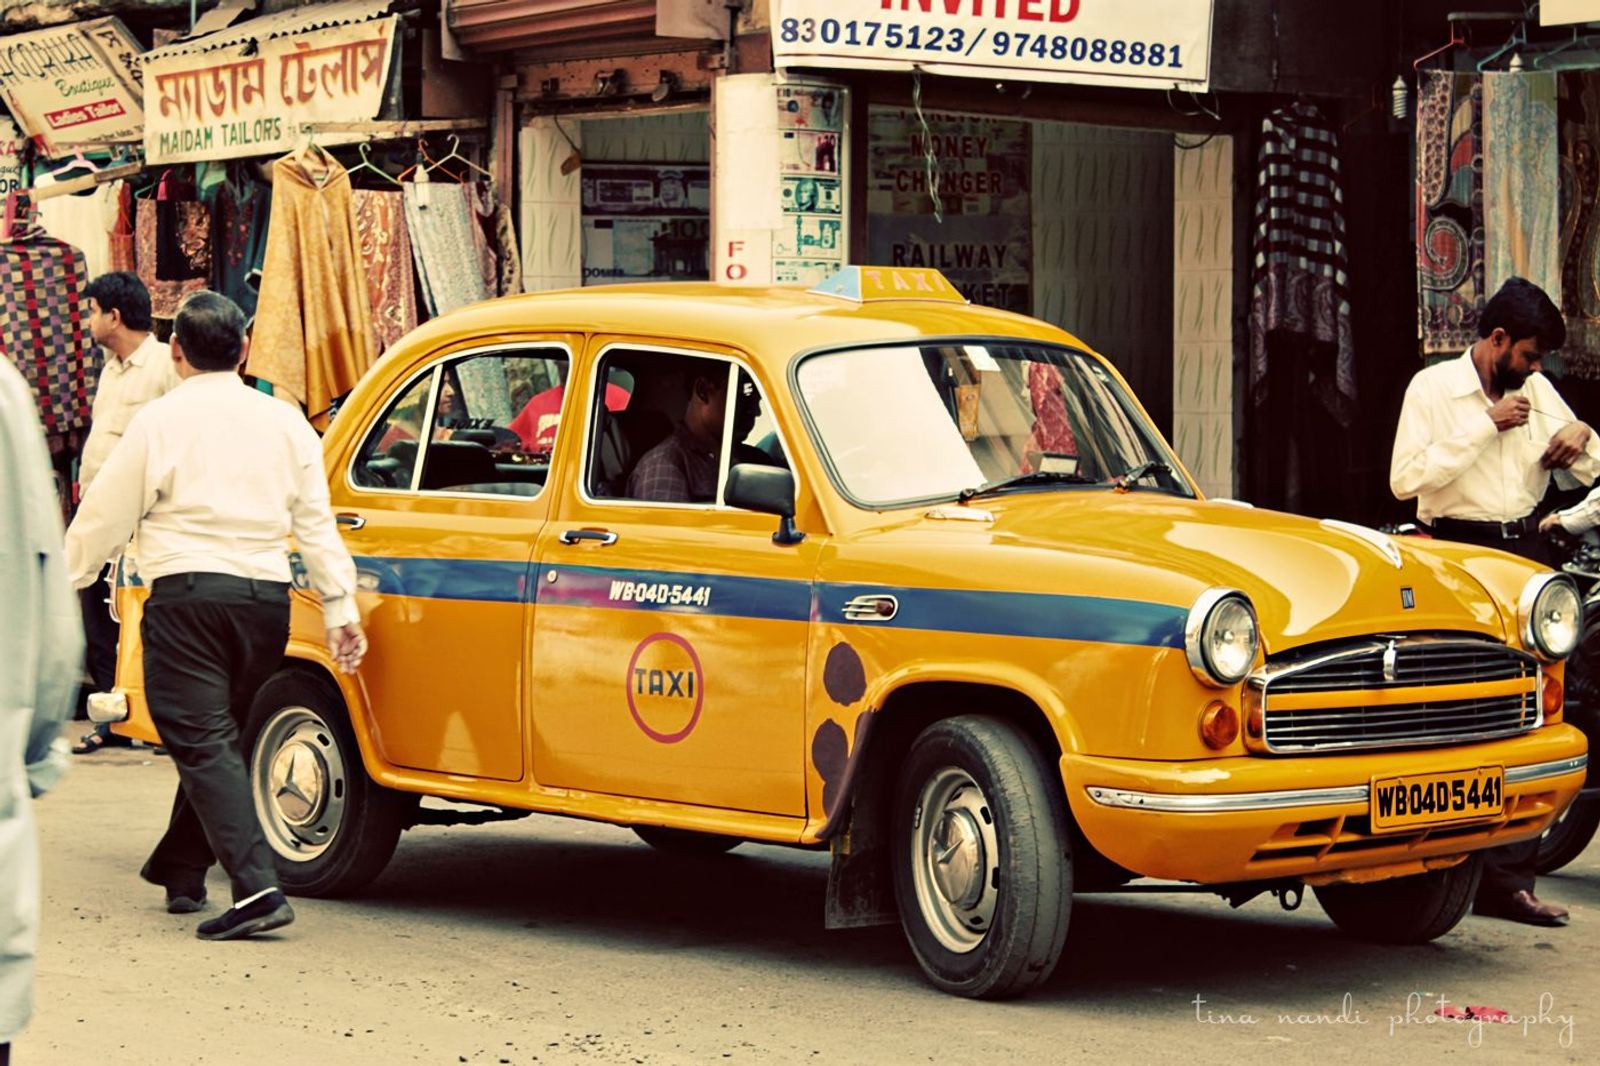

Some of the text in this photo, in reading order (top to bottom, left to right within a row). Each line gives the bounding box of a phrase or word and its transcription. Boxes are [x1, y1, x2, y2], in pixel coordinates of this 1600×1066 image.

[158, 126, 213, 156] MAIDAM
[221, 117, 281, 147] TAILORS
[911, 135, 988, 158] MONEY
[892, 244, 1007, 268] RAILWAY
[865, 270, 946, 293] TAXI
[634, 668, 694, 698] TAXI
